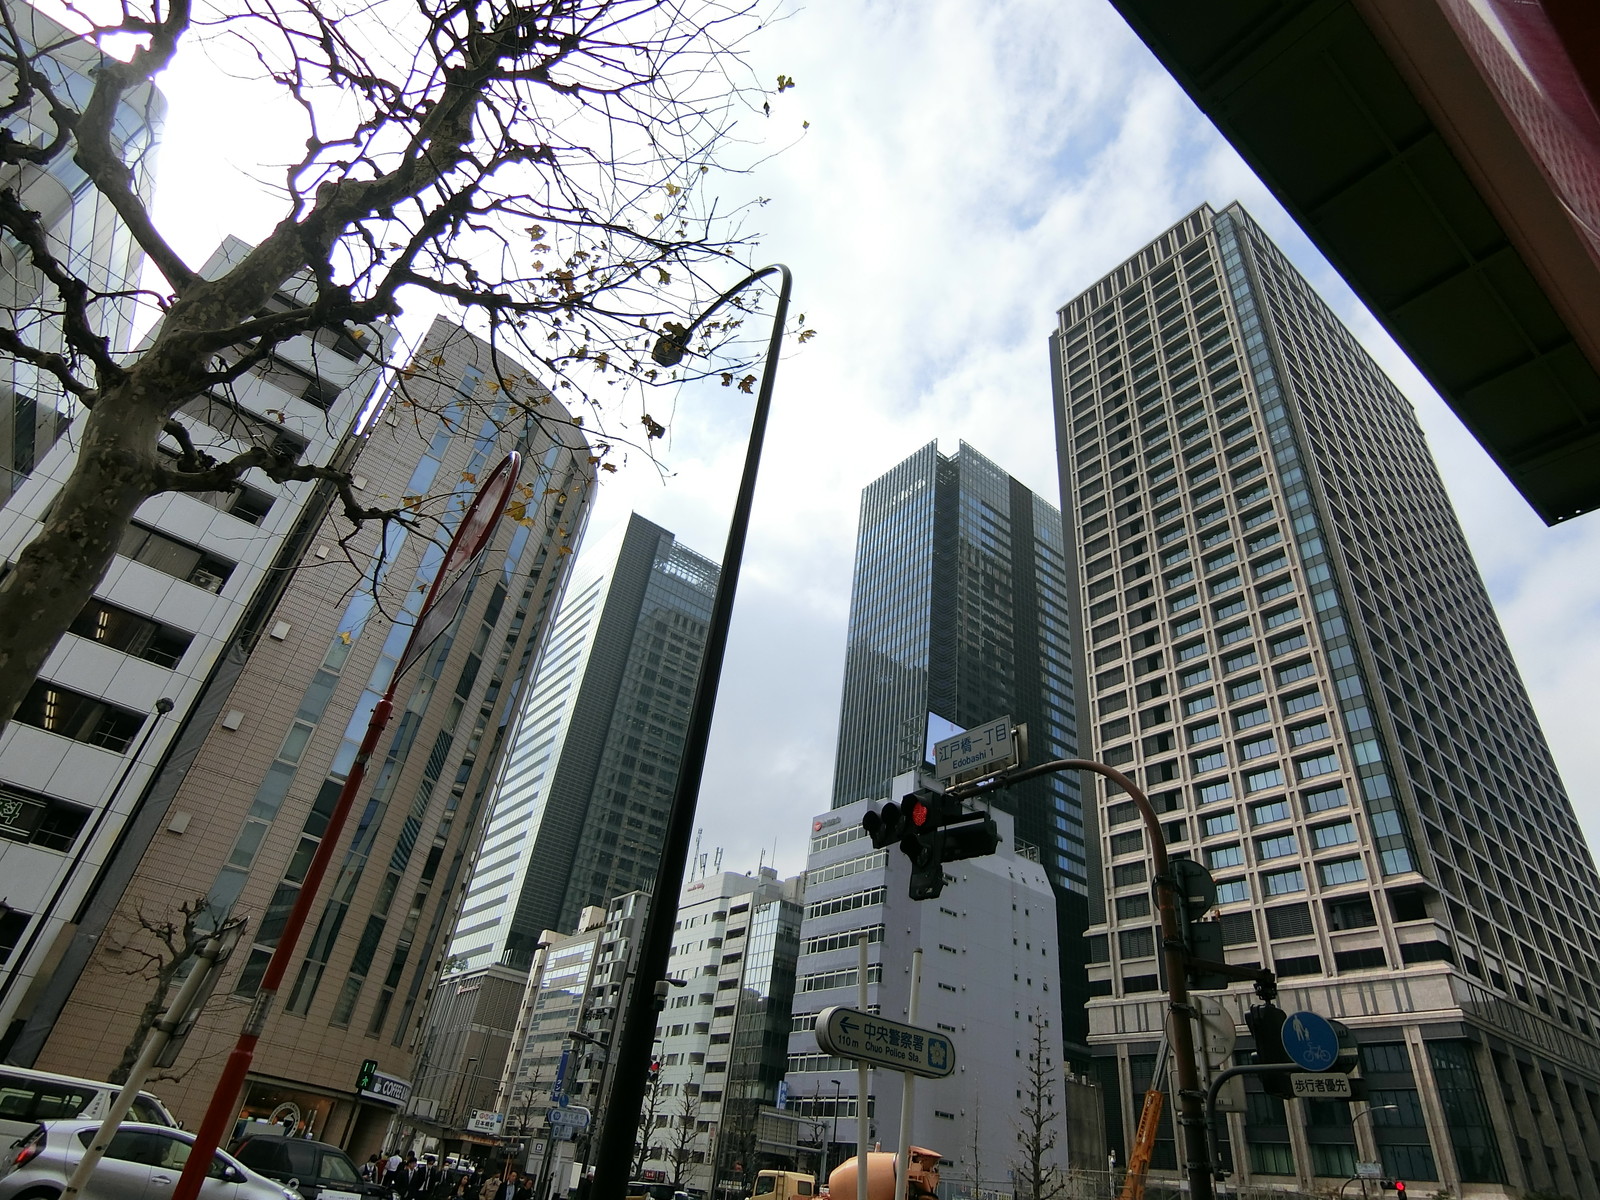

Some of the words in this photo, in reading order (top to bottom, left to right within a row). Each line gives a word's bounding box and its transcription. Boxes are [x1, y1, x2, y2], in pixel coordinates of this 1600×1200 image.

[939, 724, 1006, 762] 江戸橋一丁目
[953, 750, 986, 769] Edobashi
[990, 747, 994, 756] 1
[864, 1022, 924, 1052] 中央警察署
[865, 1041, 883, 1054] Chuo
[885, 1046, 905, 1060] Police
[908, 1052, 922, 1064] Sta.
[382, 1080, 404, 1099] COFFEE
[1294, 1078, 1348, 1093] 歩行者優先
